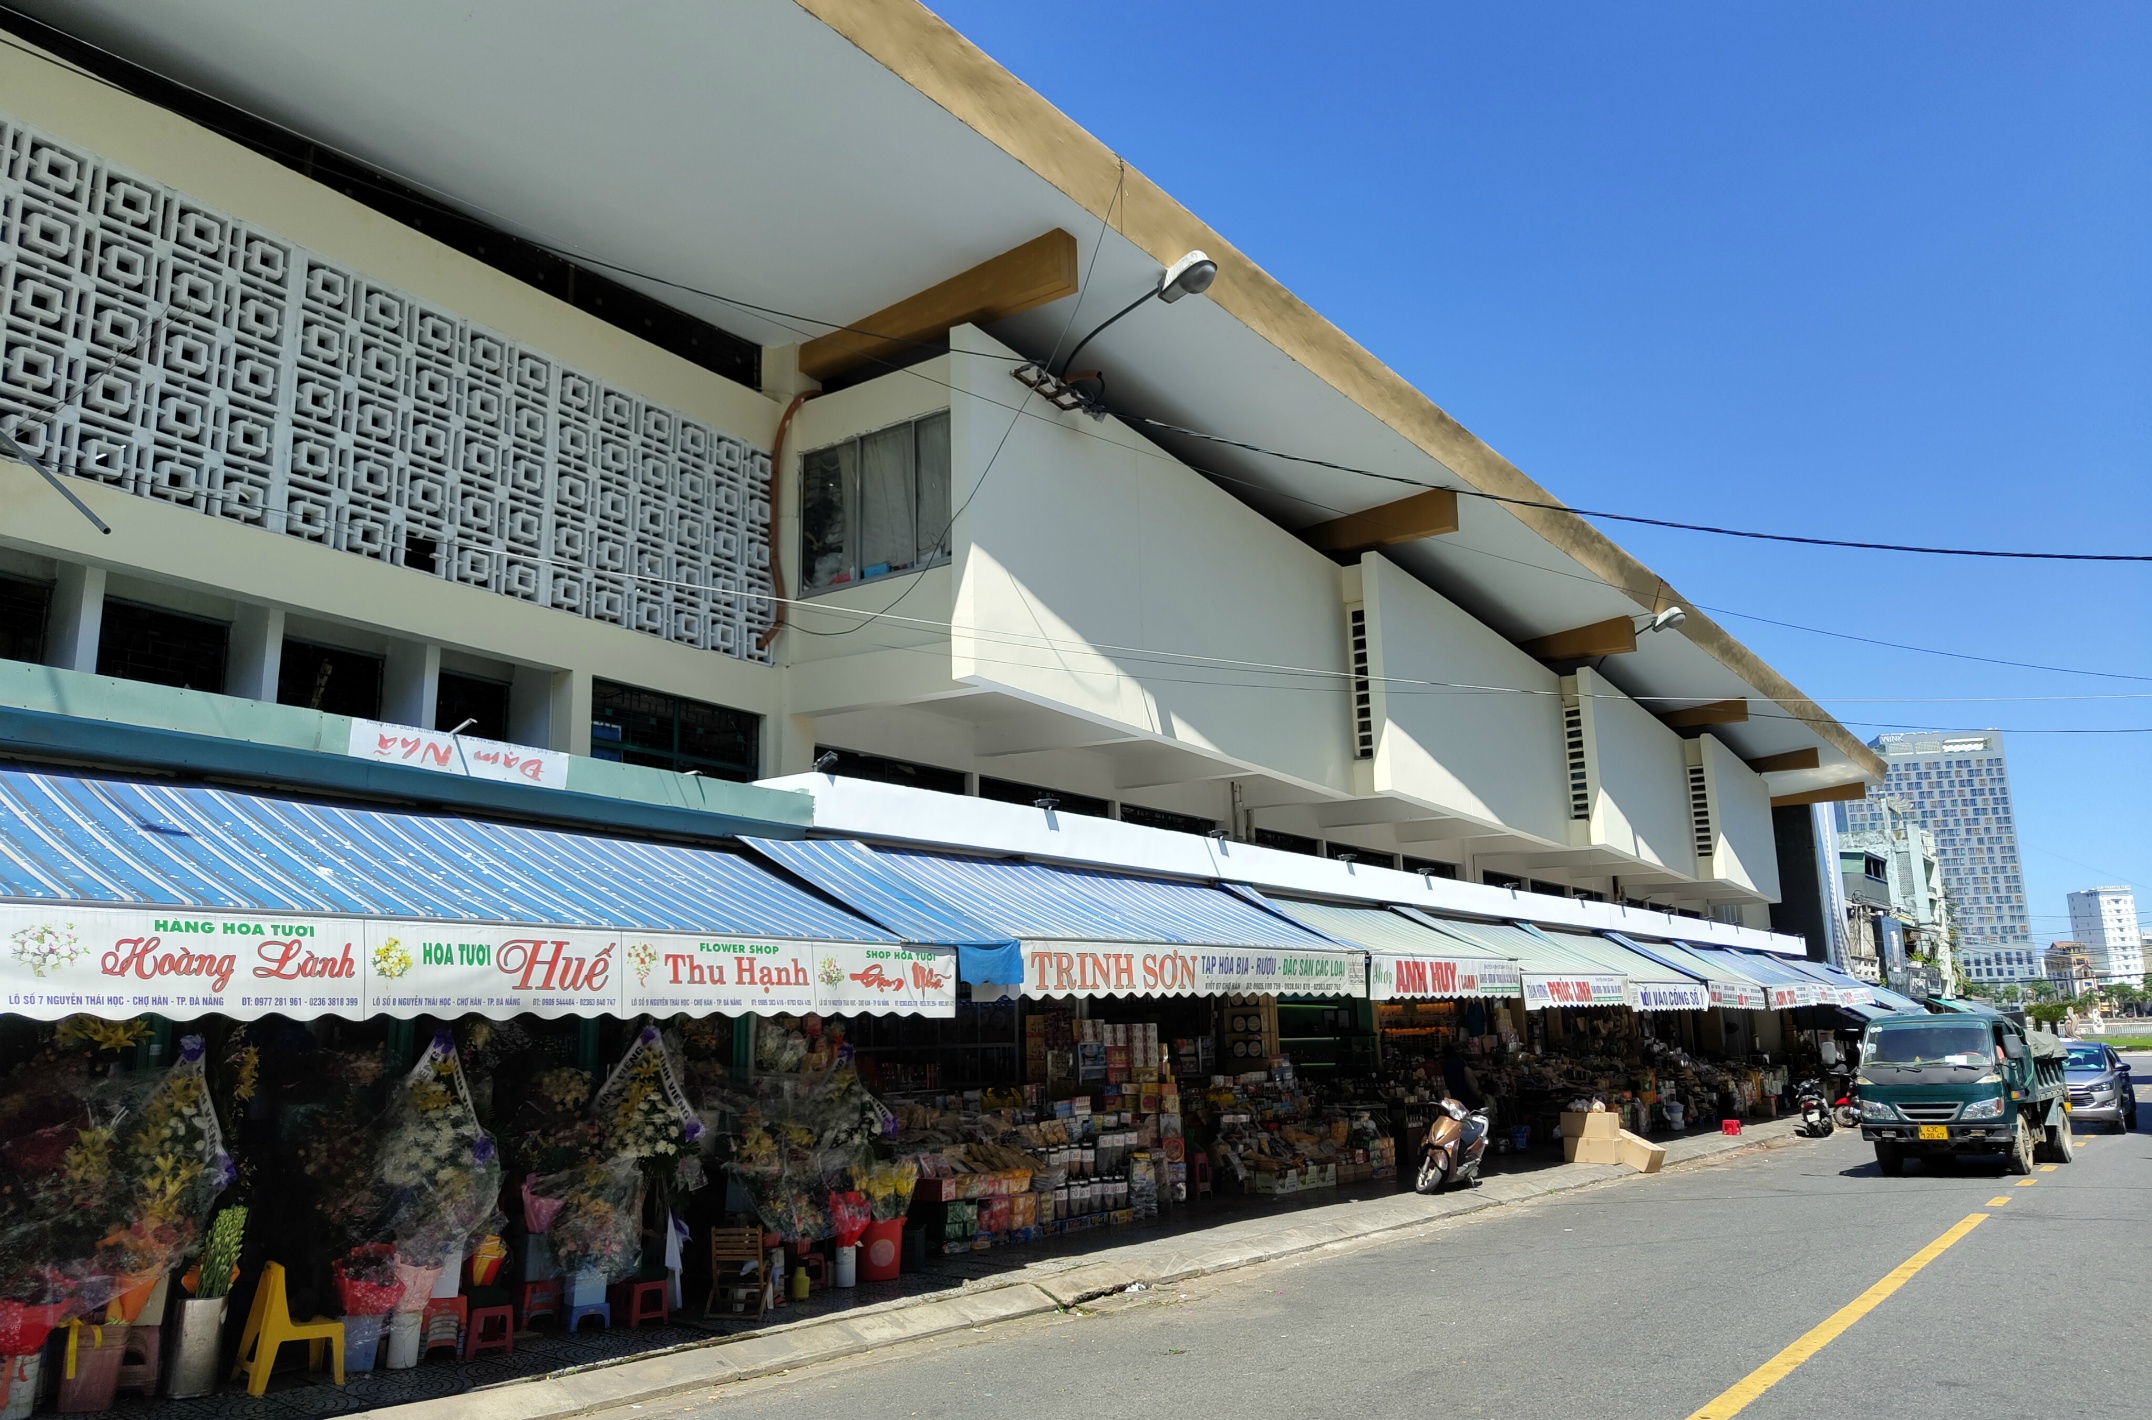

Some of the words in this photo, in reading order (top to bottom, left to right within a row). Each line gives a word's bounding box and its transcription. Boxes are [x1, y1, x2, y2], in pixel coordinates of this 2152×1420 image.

[473, 750, 544, 781] Đạm
[154, 916, 216, 935] HÀNG
[222, 923, 265, 936] HOA
[271, 924, 315, 938] TƯƠI
[422, 942, 454, 966] HOA
[458, 943, 491, 967] TƯƠI
[699, 942, 746, 954] FLOWER
[749, 944, 780, 955] SHOP
[865, 950, 891, 960] SHOP
[894, 951, 913, 961] HOA
[101, 936, 236, 993] Hoàng
[253, 939, 355, 980] Lành
[496, 939, 616, 992] Huế
[664, 954, 726, 985] Thu
[734, 956, 810, 994] Hạnh
[1031, 952, 1136, 990] TRINH
[1142, 950, 1197, 990] SƠN
[1201, 955, 1216, 979] TẠP
[1218, 953, 1234, 975] HÓA
[1283, 955, 1297, 980] ĐẶC
[1299, 954, 1314, 977] SẢN
[1315, 955, 1329, 977] CÁC
[1330, 960, 1345, 981] LOẠI
[1373, 963, 1393, 989] Shop
[1395, 960, 1428, 993] ANH
[1429, 961, 1457, 993] HUY
[9, 993, 20, 1005] LÔ
[23, 992, 36, 1005] SỐ
[38, 995, 44, 1005] 7
[47, 992, 83, 1005] NGUYỄN
[85, 994, 105, 1005] THÁI
[107, 995, 125, 1008] HỌC
[132, 995, 150, 1008] CHỢ
[151, 994, 169, 1006] HÀN
[177, 996, 187, 1006] TP.
[189, 995, 200, 1006] ĐÀ
[241, 996, 253, 1006] ĐT:
[254, 997, 273, 1006] 0977
[274, 997, 287, 1006] 281
[289, 997, 302, 1007] 961
[309, 997, 326, 1007] 0236
[327, 997, 344, 1007] 3818
[345, 997, 358, 1007] 399
[1547, 976, 1575, 1002] PHÚC
